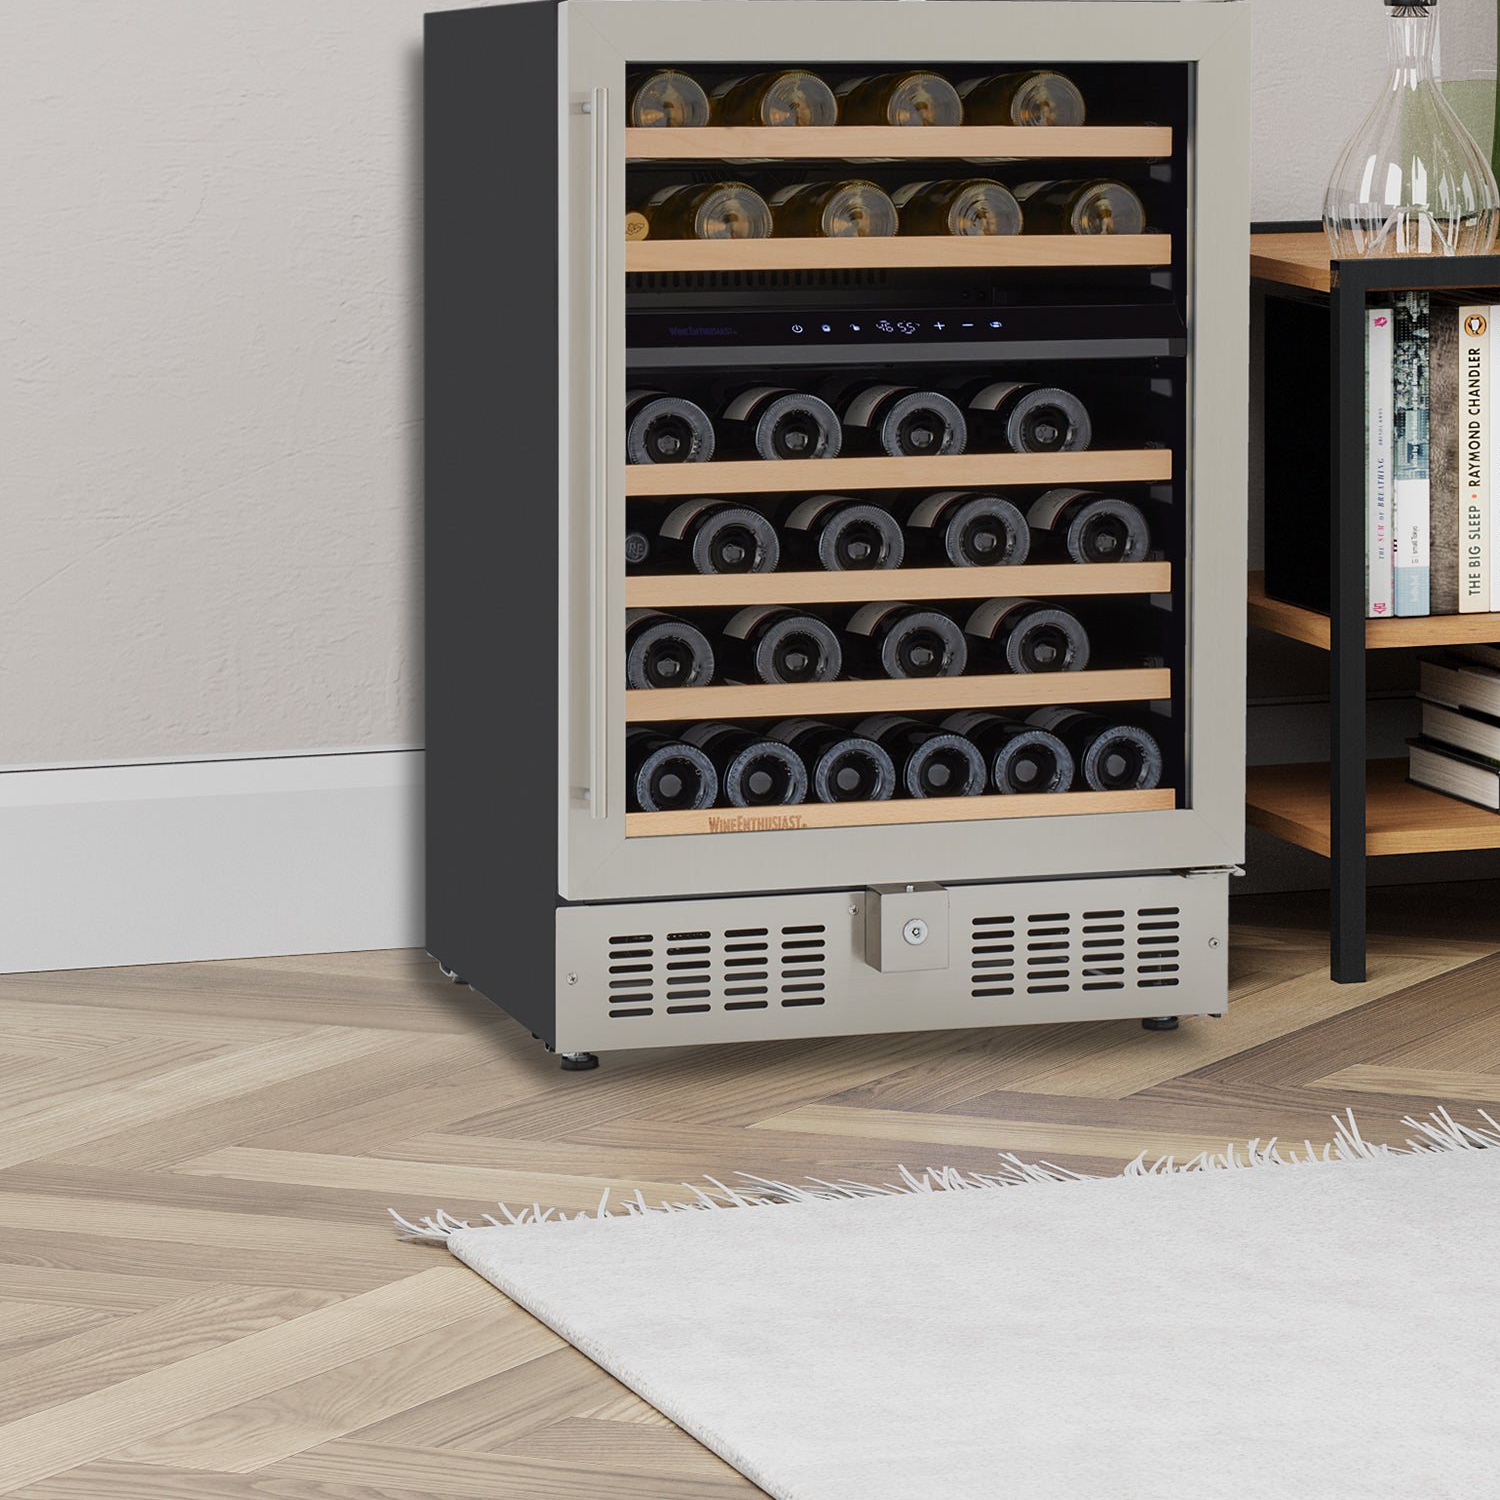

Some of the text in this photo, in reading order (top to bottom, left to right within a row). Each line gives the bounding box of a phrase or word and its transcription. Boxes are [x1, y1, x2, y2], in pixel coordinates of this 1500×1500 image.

[1377, 458, 1385, 508] BREATHING
[1468, 348, 1481, 596] THE BIG SLEEP RAYMOND CHANDLER
[1411, 526, 1419, 540] Tokyo
